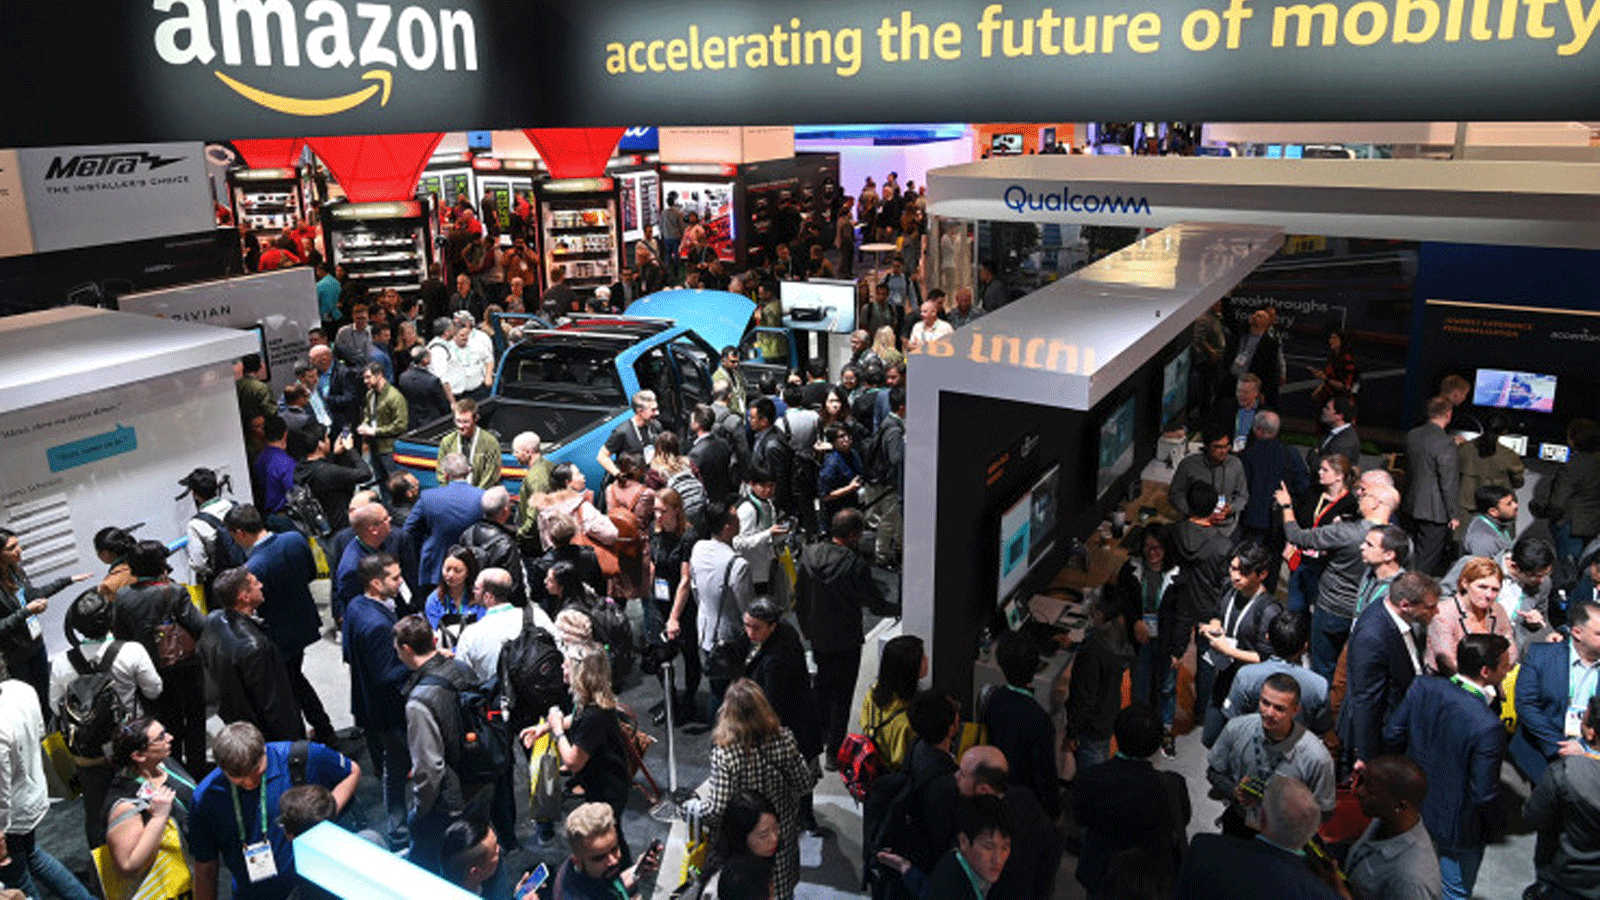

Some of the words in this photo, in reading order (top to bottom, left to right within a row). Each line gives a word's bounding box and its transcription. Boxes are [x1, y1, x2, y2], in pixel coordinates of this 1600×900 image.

[153, 0, 478, 71] amazon
[606, 18, 863, 77] accelerating
[876, 11, 963, 61] the
[976, 4, 1162, 58] future
[1180, 0, 1255, 52] of
[1271, 0, 1600, 56] mobility
[46, 185, 70, 195] THE
[73, 178, 146, 193] INSTALLER'S
[150, 175, 189, 187] CHOICE
[1003, 184, 1152, 215] Qualcomm
